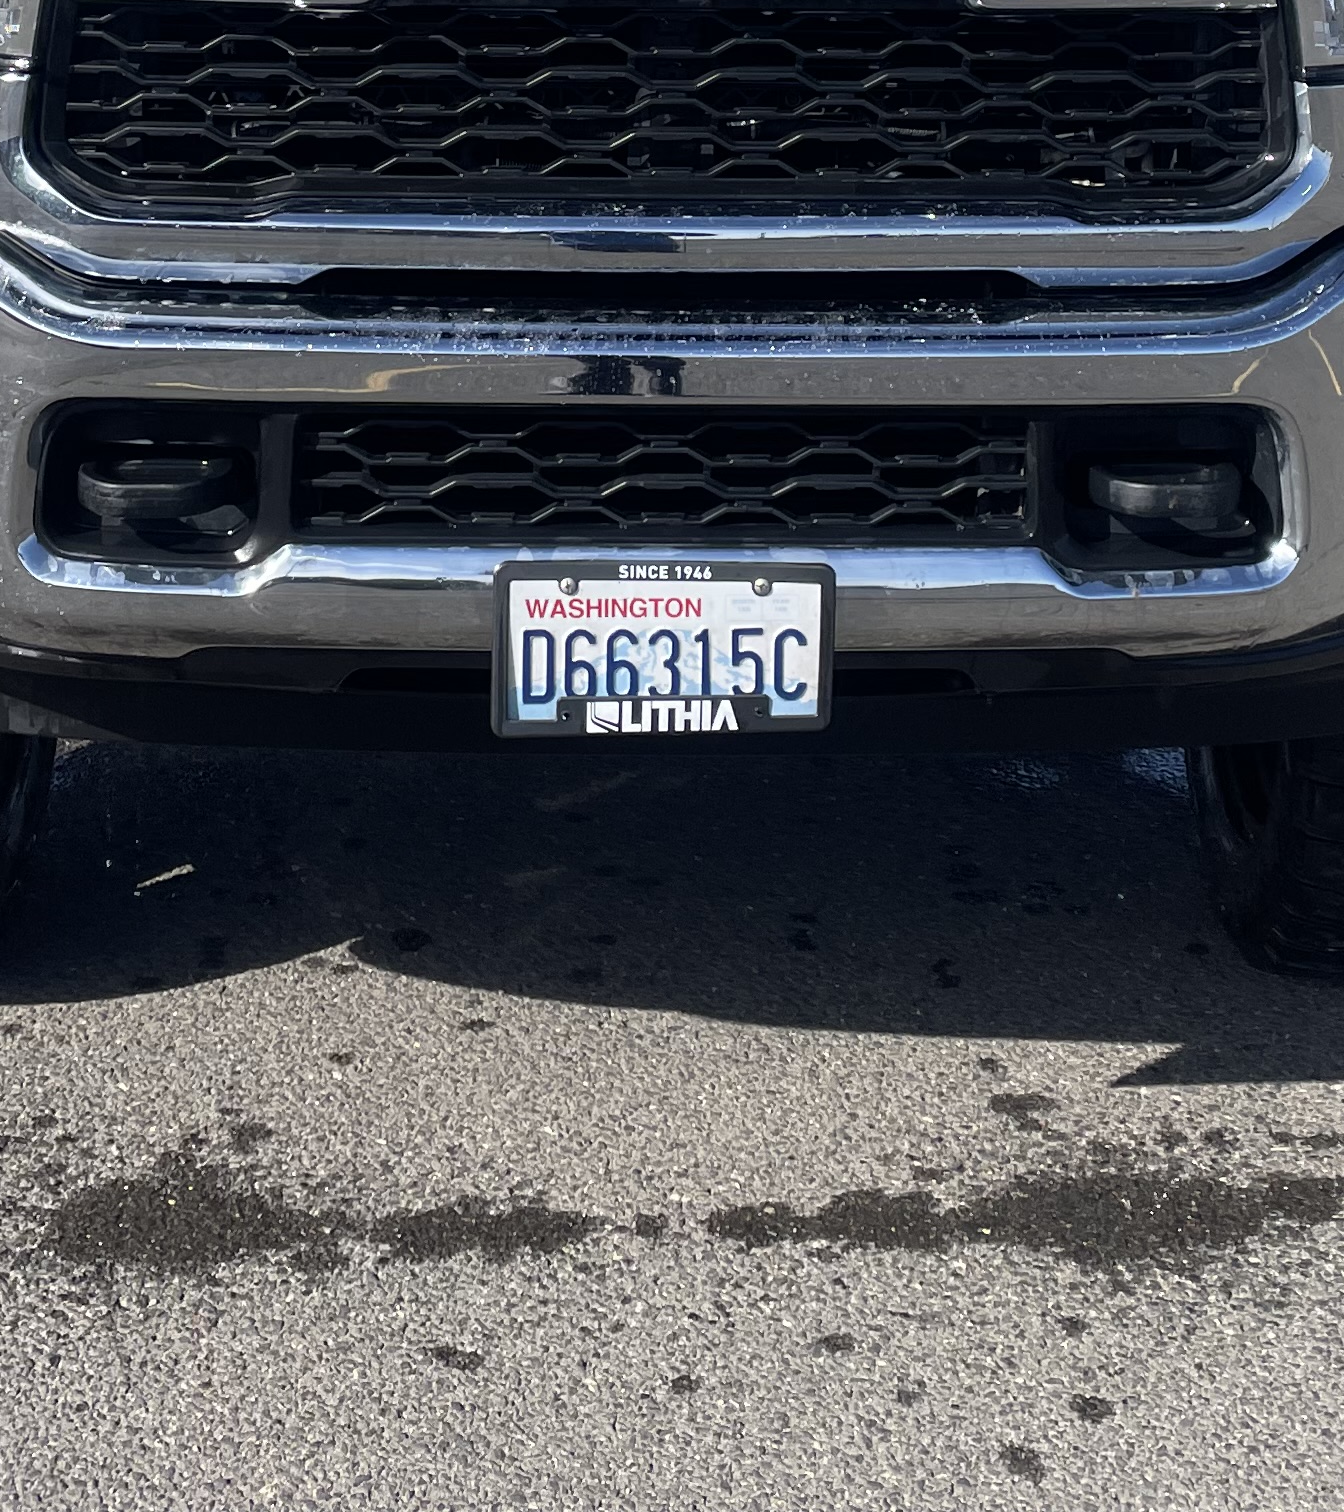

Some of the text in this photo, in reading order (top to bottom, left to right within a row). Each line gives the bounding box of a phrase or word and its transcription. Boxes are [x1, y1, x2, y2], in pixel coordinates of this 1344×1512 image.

[618, 564, 712, 580] SINCE 1946
[525, 597, 702, 619] WASHINGTON
[522, 627, 808, 704] D66315C
[619, 699, 739, 733] LITHIA
